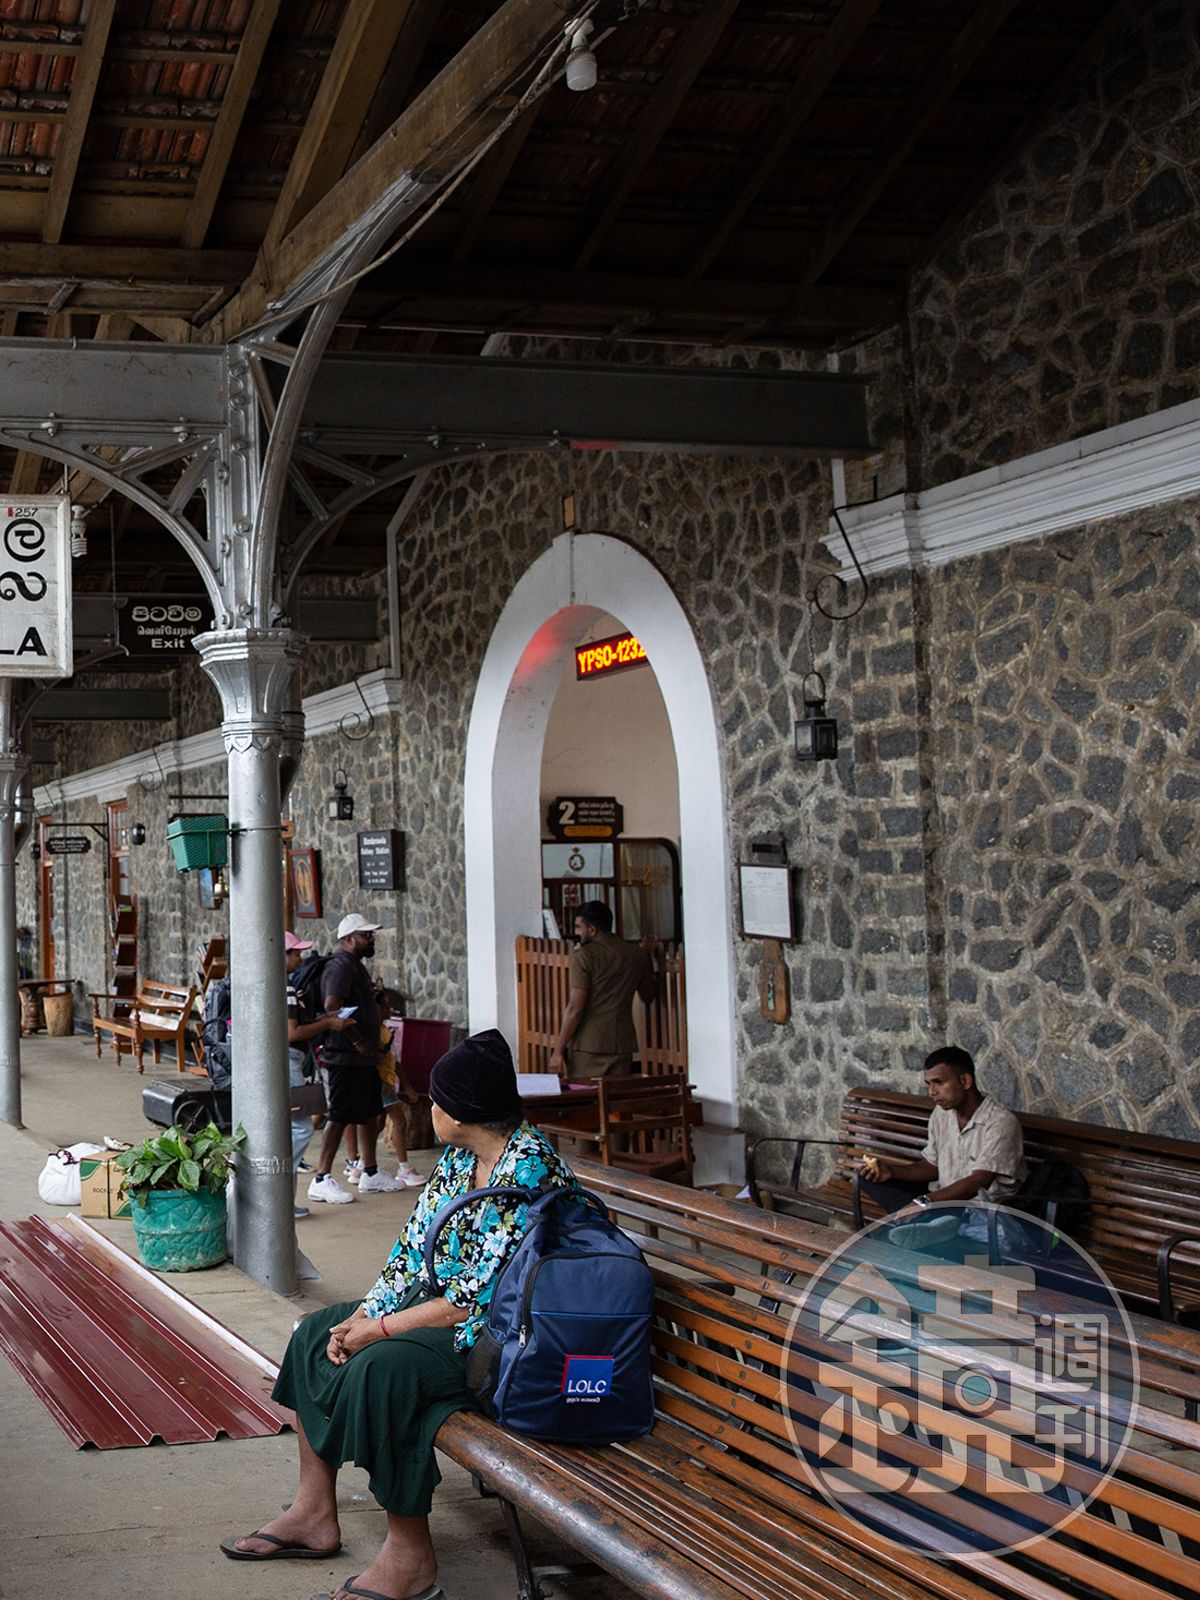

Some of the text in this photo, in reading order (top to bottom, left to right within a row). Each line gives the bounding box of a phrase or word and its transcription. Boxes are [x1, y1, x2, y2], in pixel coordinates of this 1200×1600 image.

[15, 507, 39, 517] 257
[151, 638, 186, 649] Exit
[558, 800, 576, 825] 2
[567, 1379, 607, 1394] LOLC
